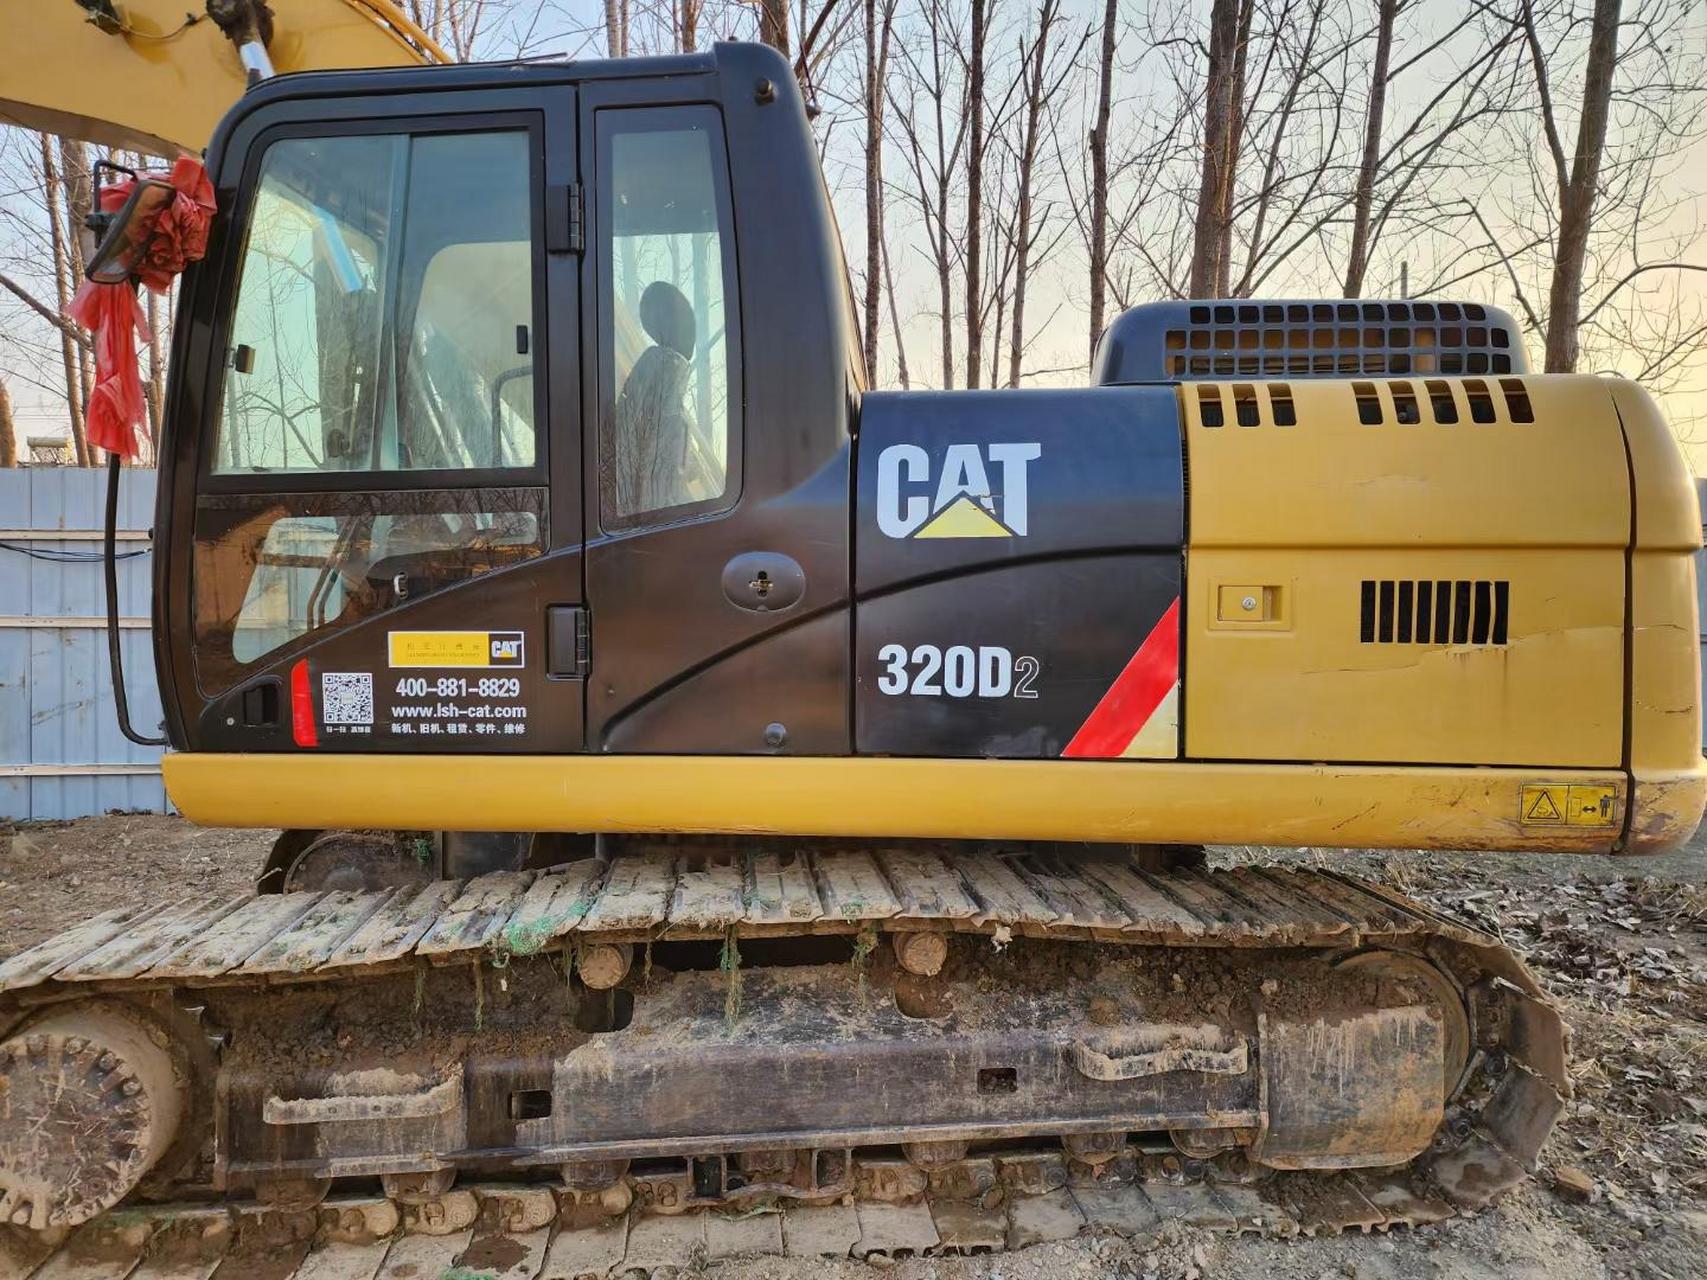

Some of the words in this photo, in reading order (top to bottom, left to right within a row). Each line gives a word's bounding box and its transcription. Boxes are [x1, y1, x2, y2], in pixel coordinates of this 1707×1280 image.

[876, 442, 1042, 539] CAT
[491, 640, 522, 658] CAT
[877, 643, 1040, 699] 320D2
[395, 678, 520, 697] 400-881-8829
[391, 702, 527, 718] www.lsh-cat.com
